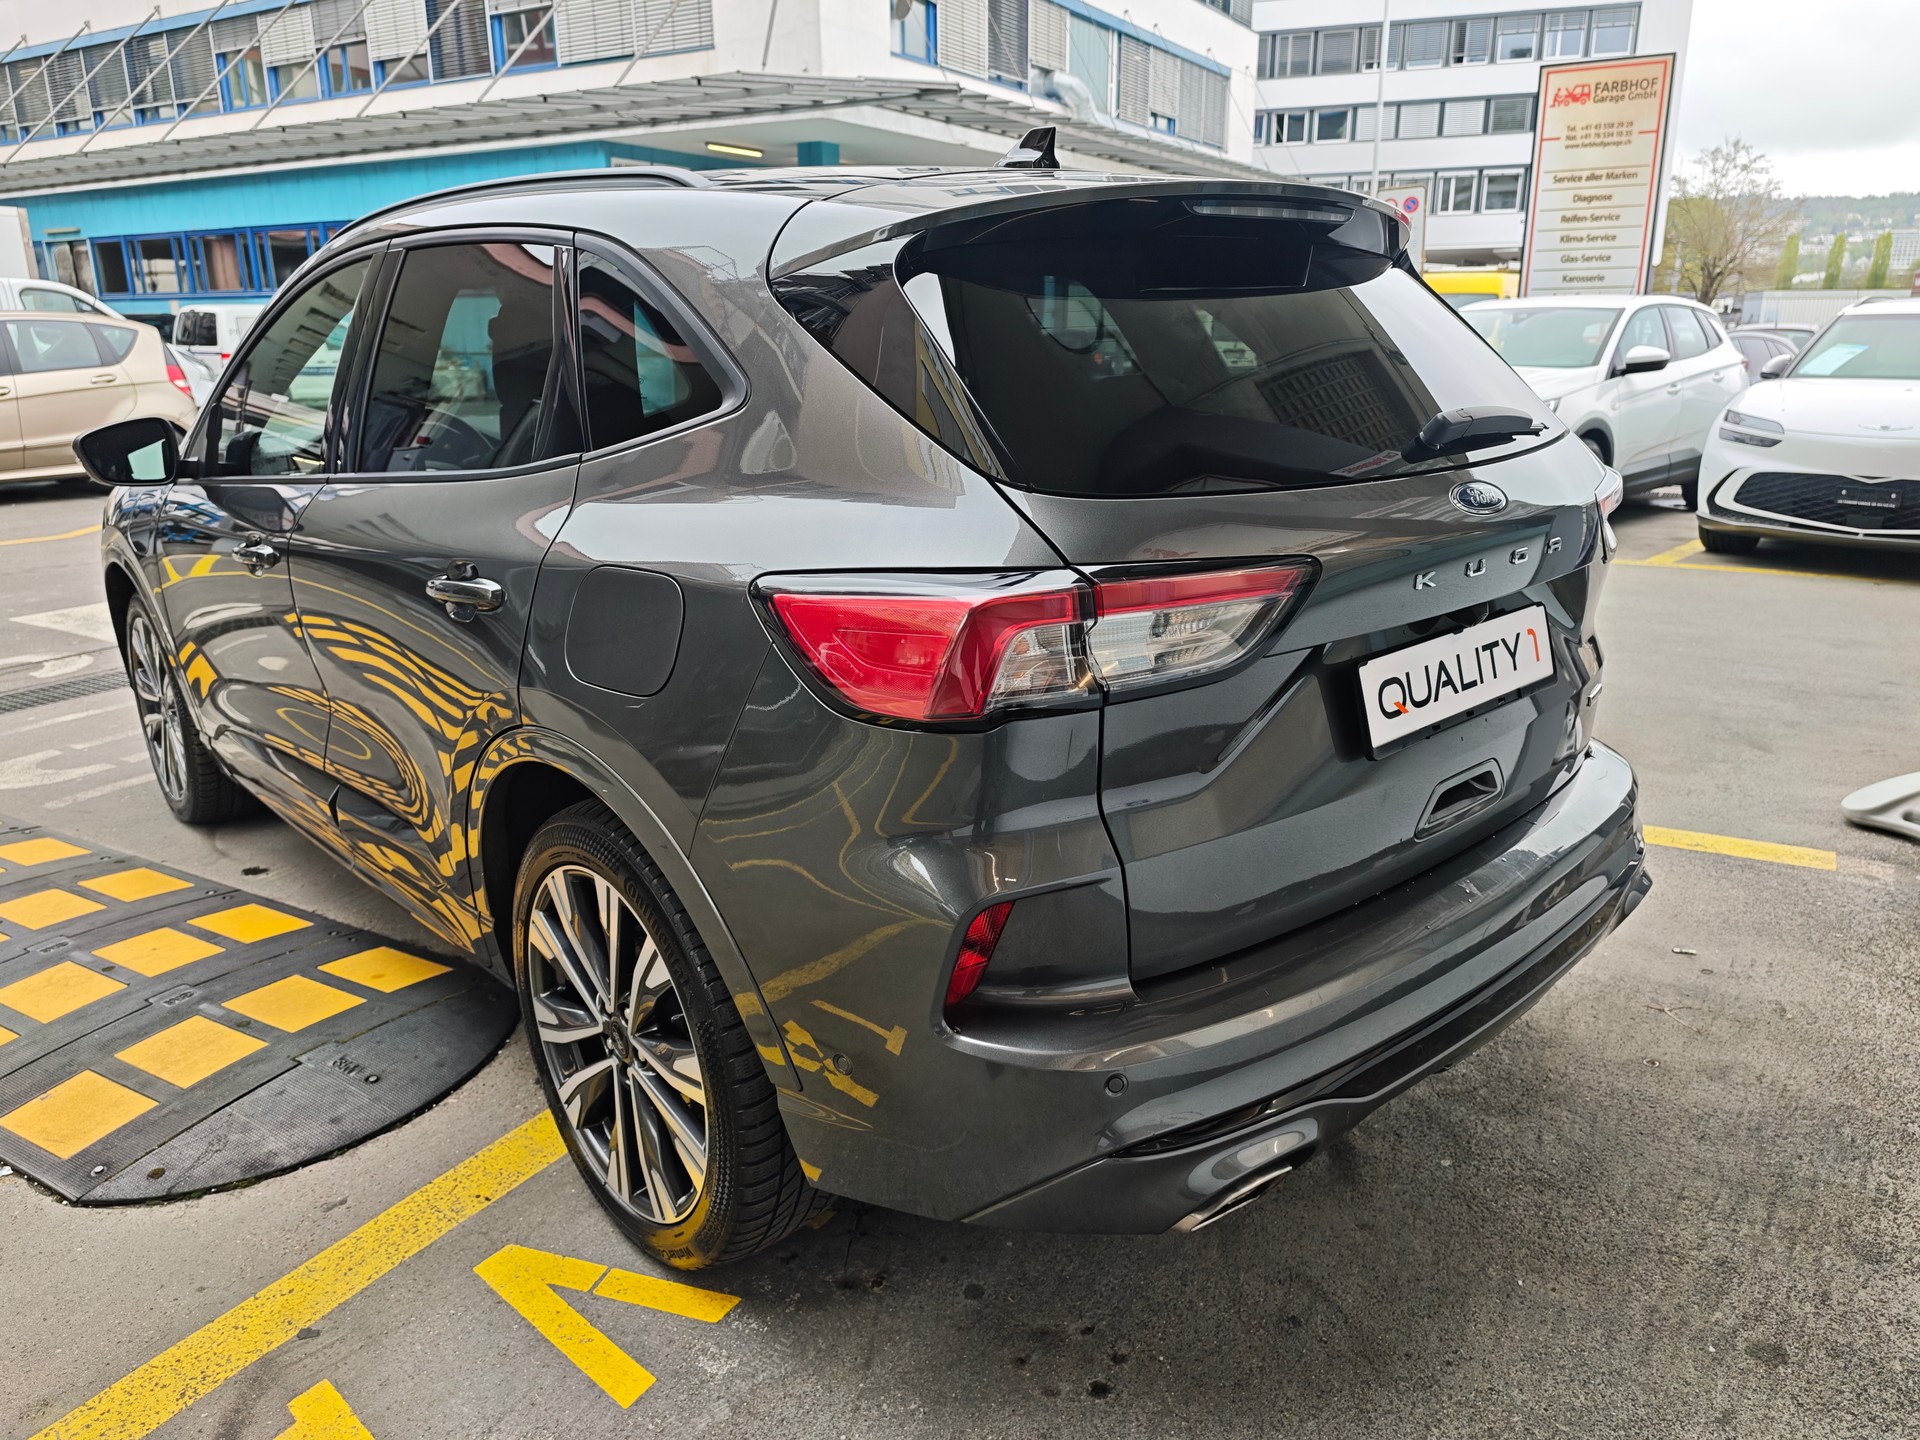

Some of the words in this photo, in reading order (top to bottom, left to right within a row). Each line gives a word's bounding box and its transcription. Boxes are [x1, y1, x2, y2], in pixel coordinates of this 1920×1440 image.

[1594, 77, 1658, 94] FARBHOF
[1593, 93, 1625, 104] Garage
[1628, 91, 1657, 101] GmbH
[1564, 139, 1632, 150] www.farbhofgarage.ch
[1552, 174, 1583, 185] Service
[1585, 173, 1603, 182] aller
[1605, 171, 1638, 181] Marken
[1572, 193, 1613, 205] Diagnose
[1560, 212, 1621, 223] Reifen-Service
[1560, 233, 1617, 244] Klima-Service
[1560, 254, 1612, 264] Glas-Service
[1561, 274, 1605, 283] Karosserie
[1466, 487, 1502, 506] Ford
[1413, 537, 1562, 590] KUGA
